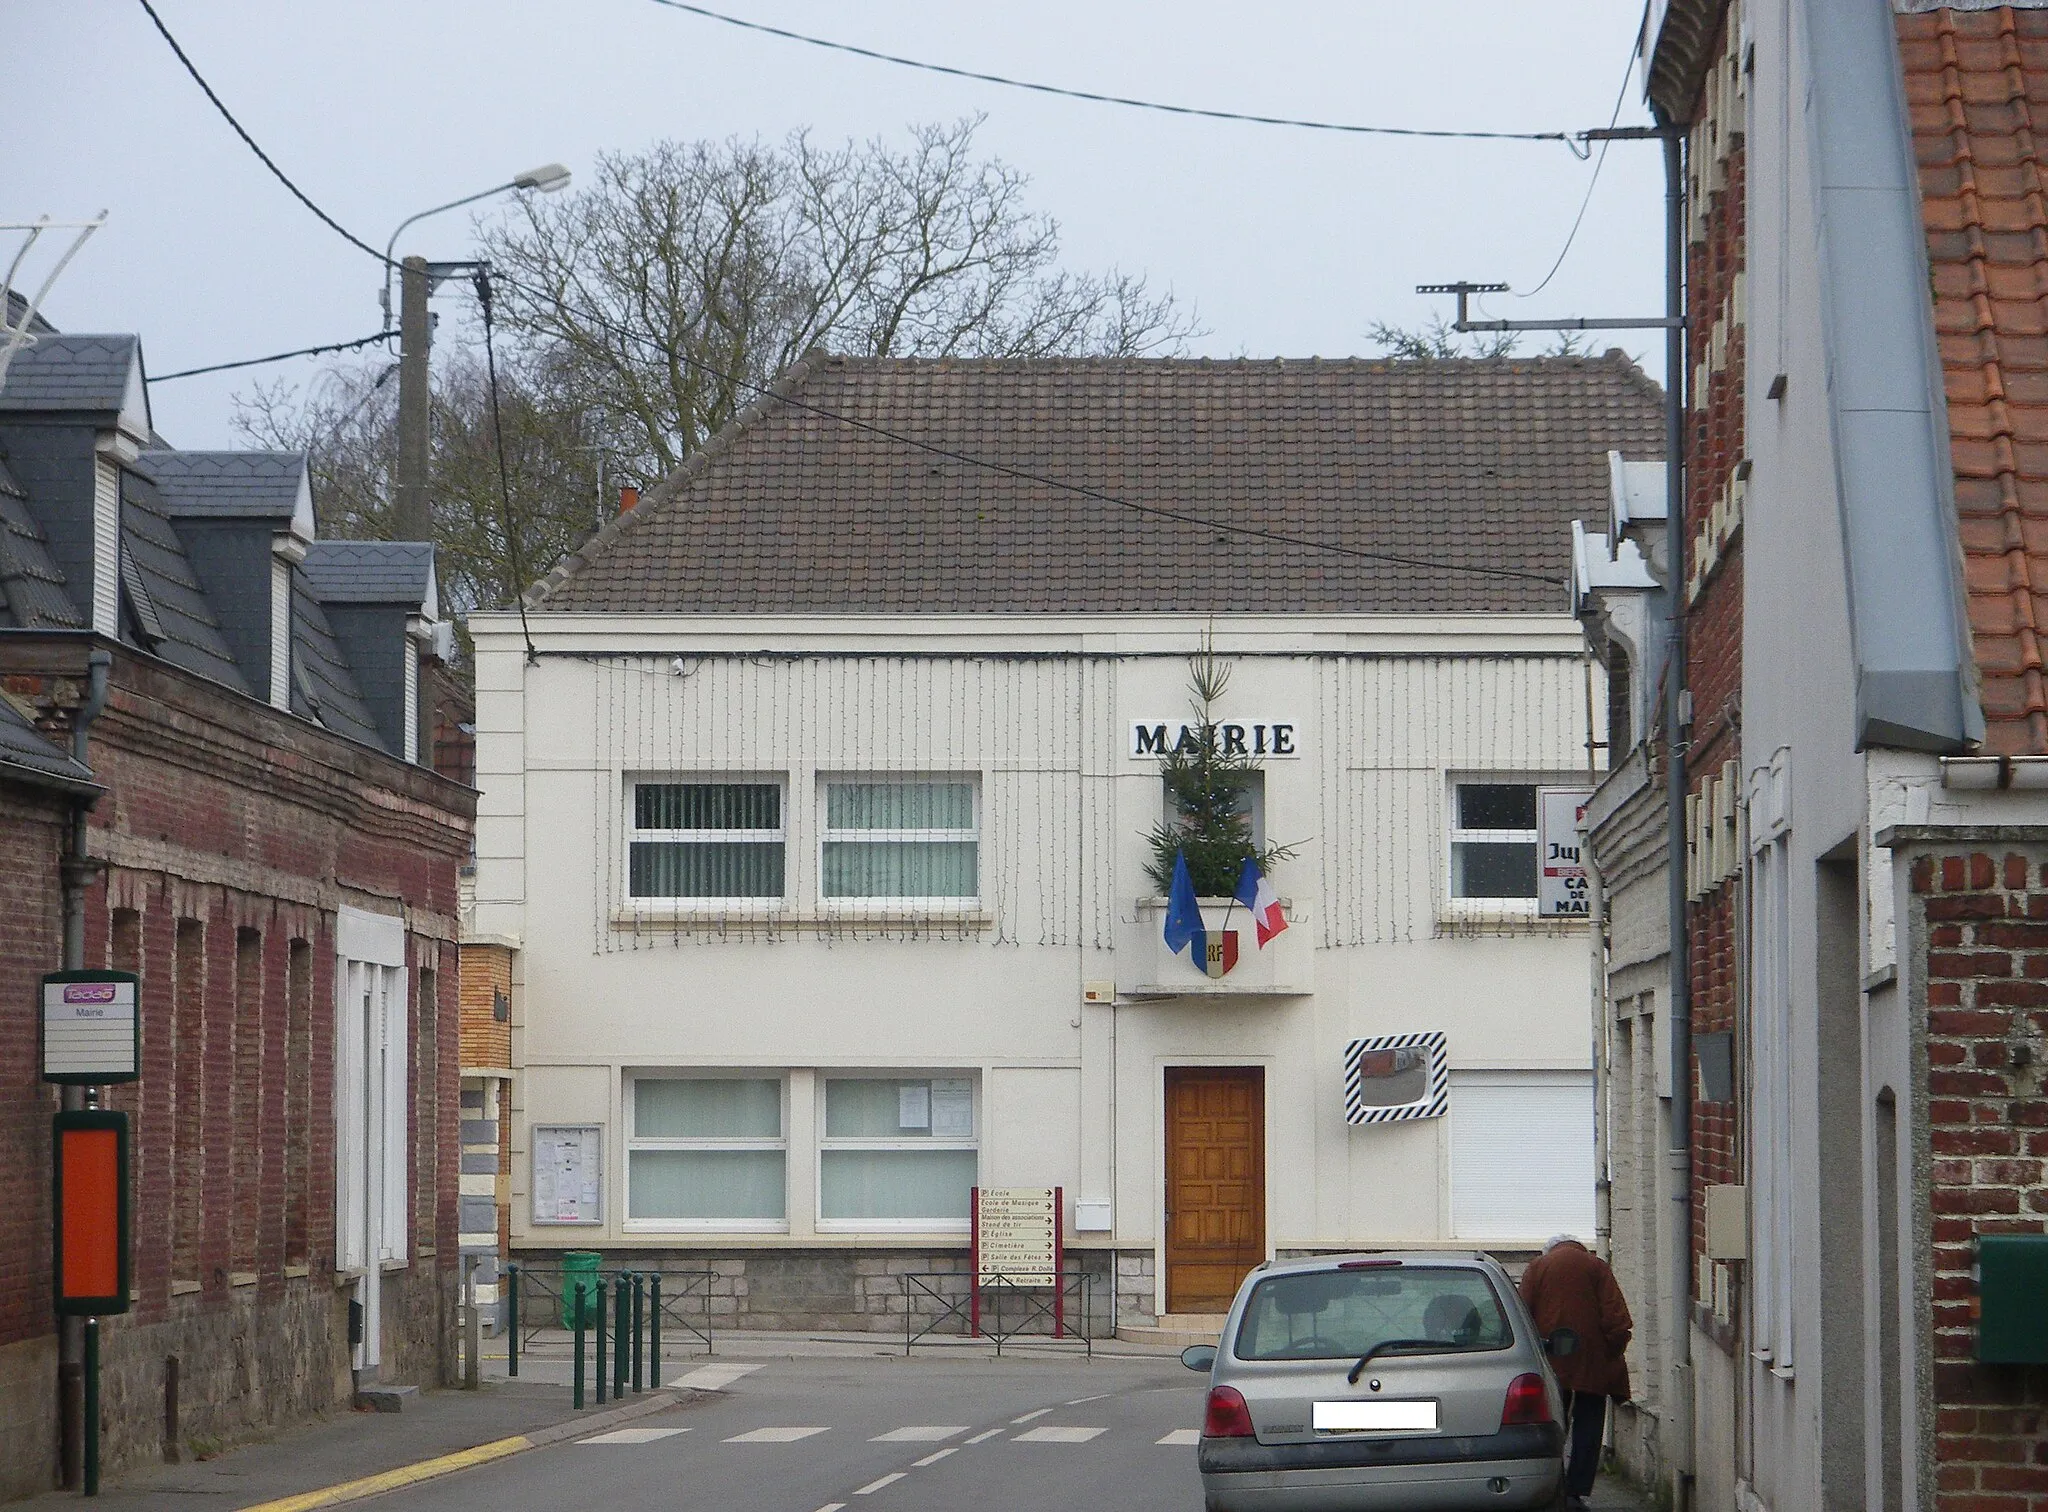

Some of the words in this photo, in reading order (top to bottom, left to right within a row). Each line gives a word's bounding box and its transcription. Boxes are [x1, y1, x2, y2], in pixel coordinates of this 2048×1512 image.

[1570, 891, 1585, 899] DE
[1207, 944, 1224, 962] RF
[76, 1008, 104, 1017] Mairie
[1000, 1265, 1030, 1273] Complexe
